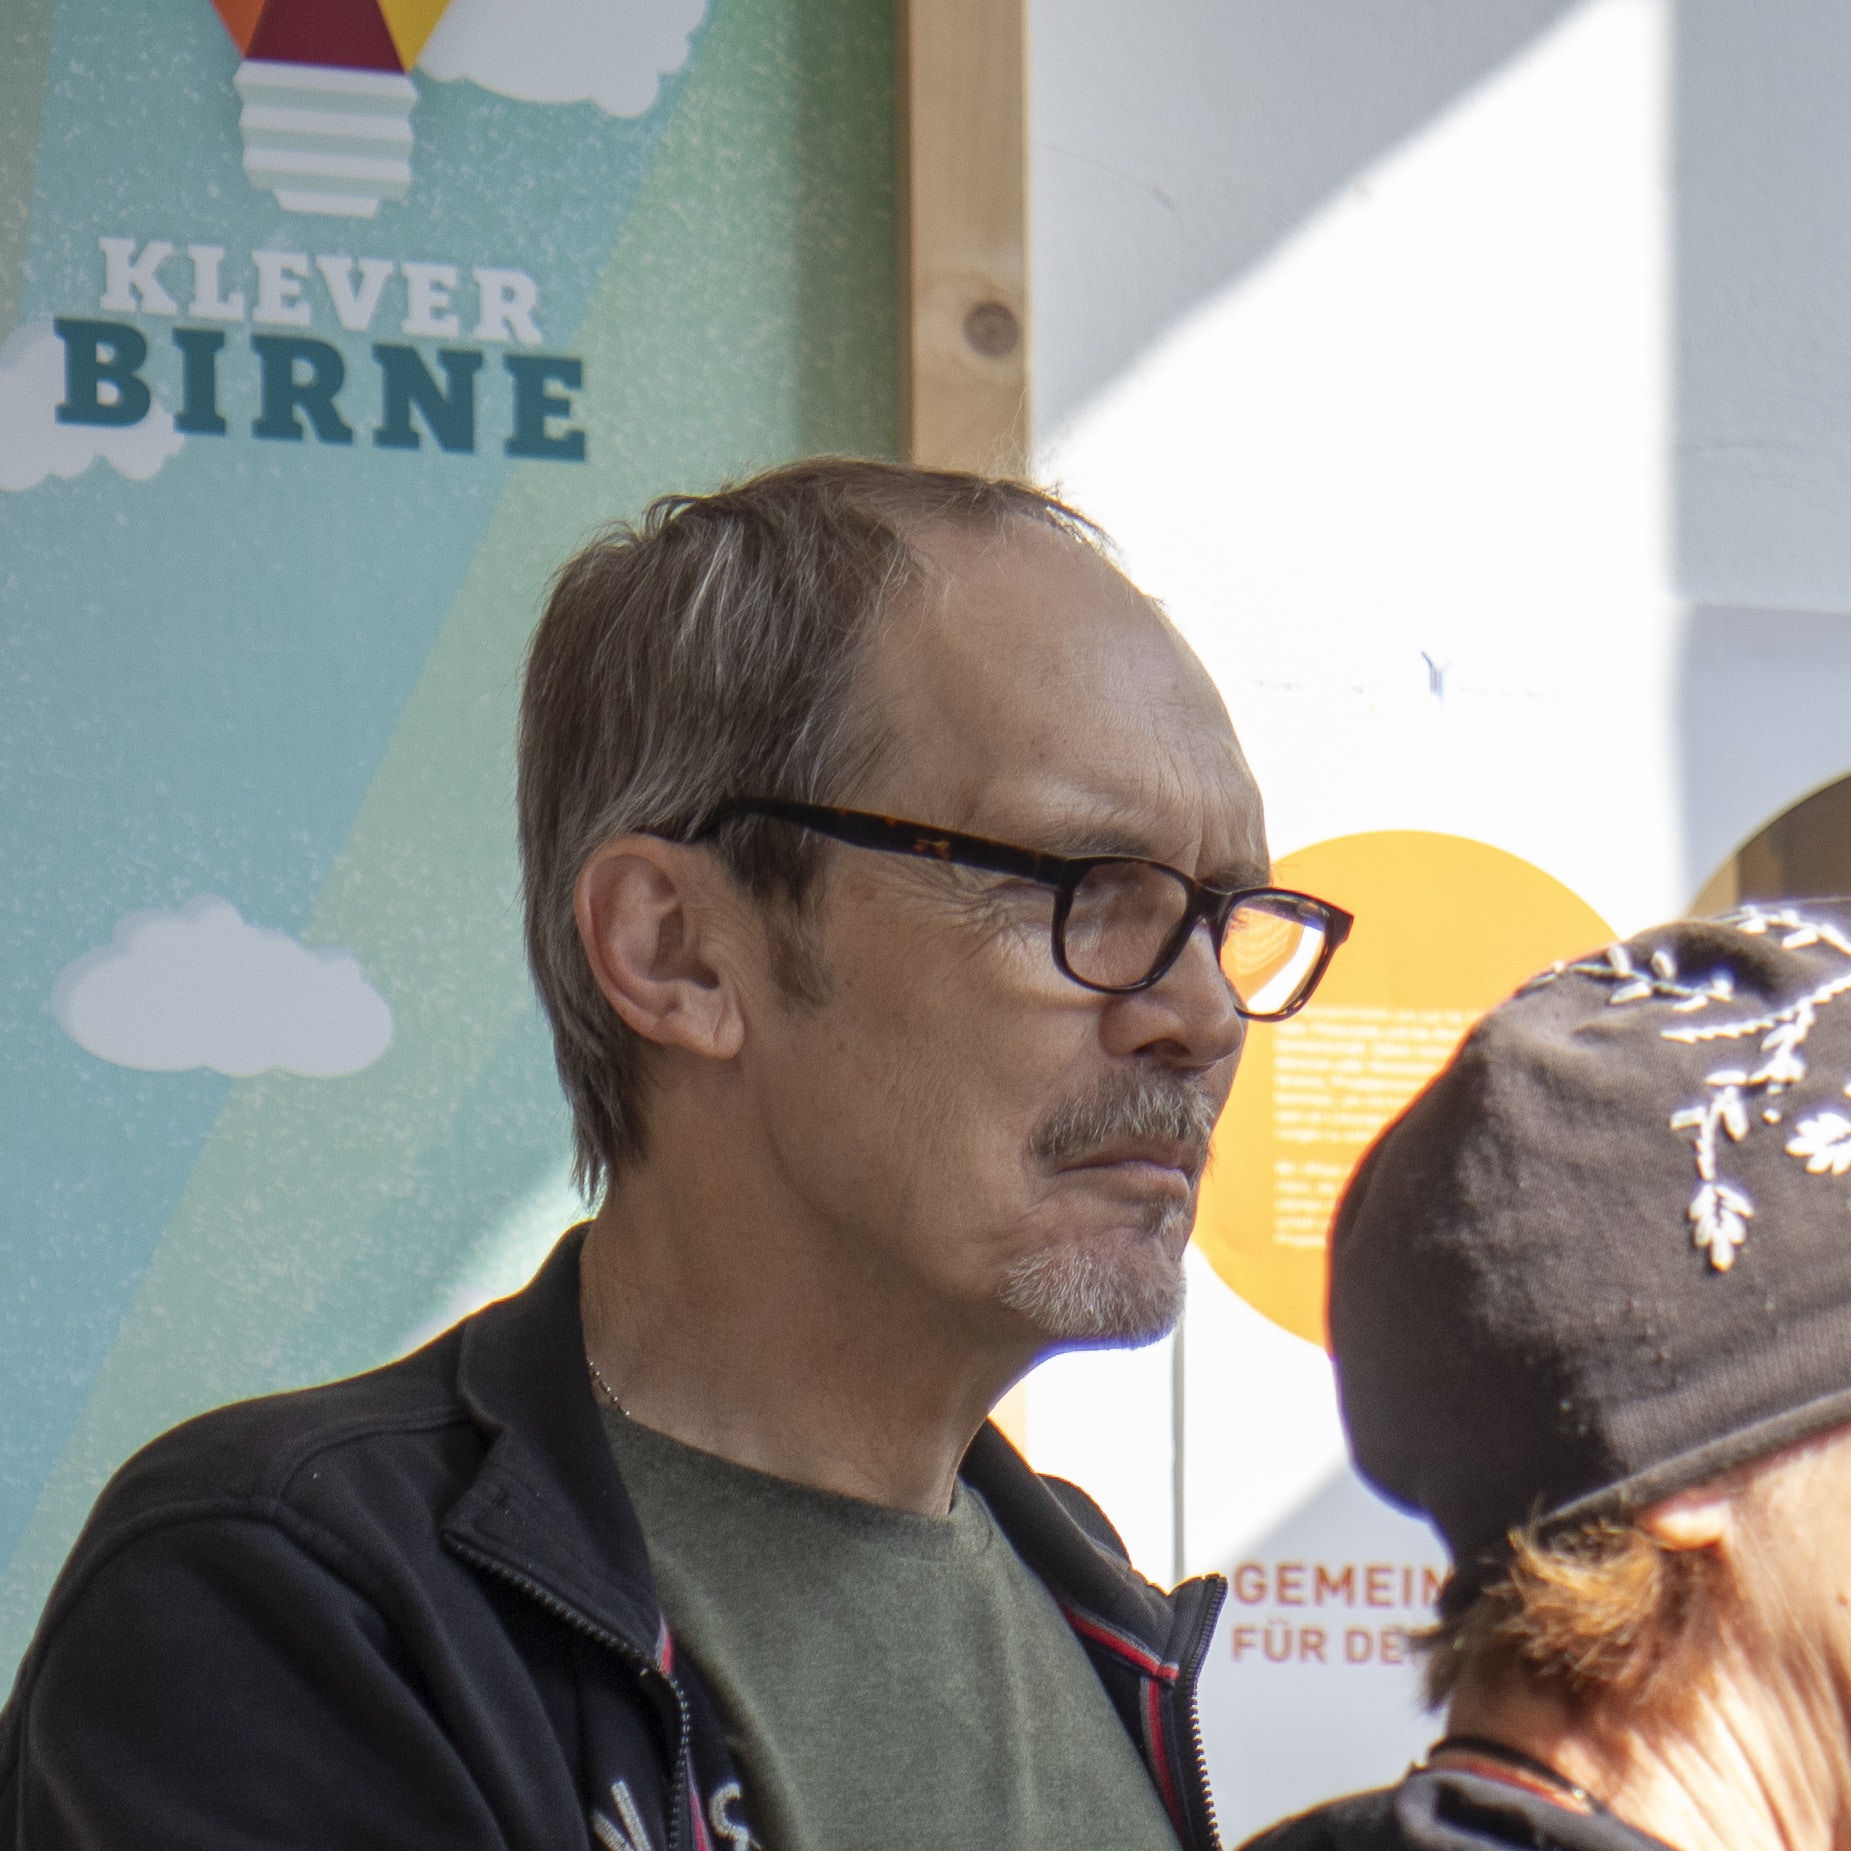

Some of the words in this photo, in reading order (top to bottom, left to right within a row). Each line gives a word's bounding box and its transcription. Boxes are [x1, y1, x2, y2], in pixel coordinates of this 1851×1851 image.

[99, 236, 543, 346] KLEVER
[55, 317, 586, 462] BIRNE
[1231, 1618, 1327, 1663] FÜR
